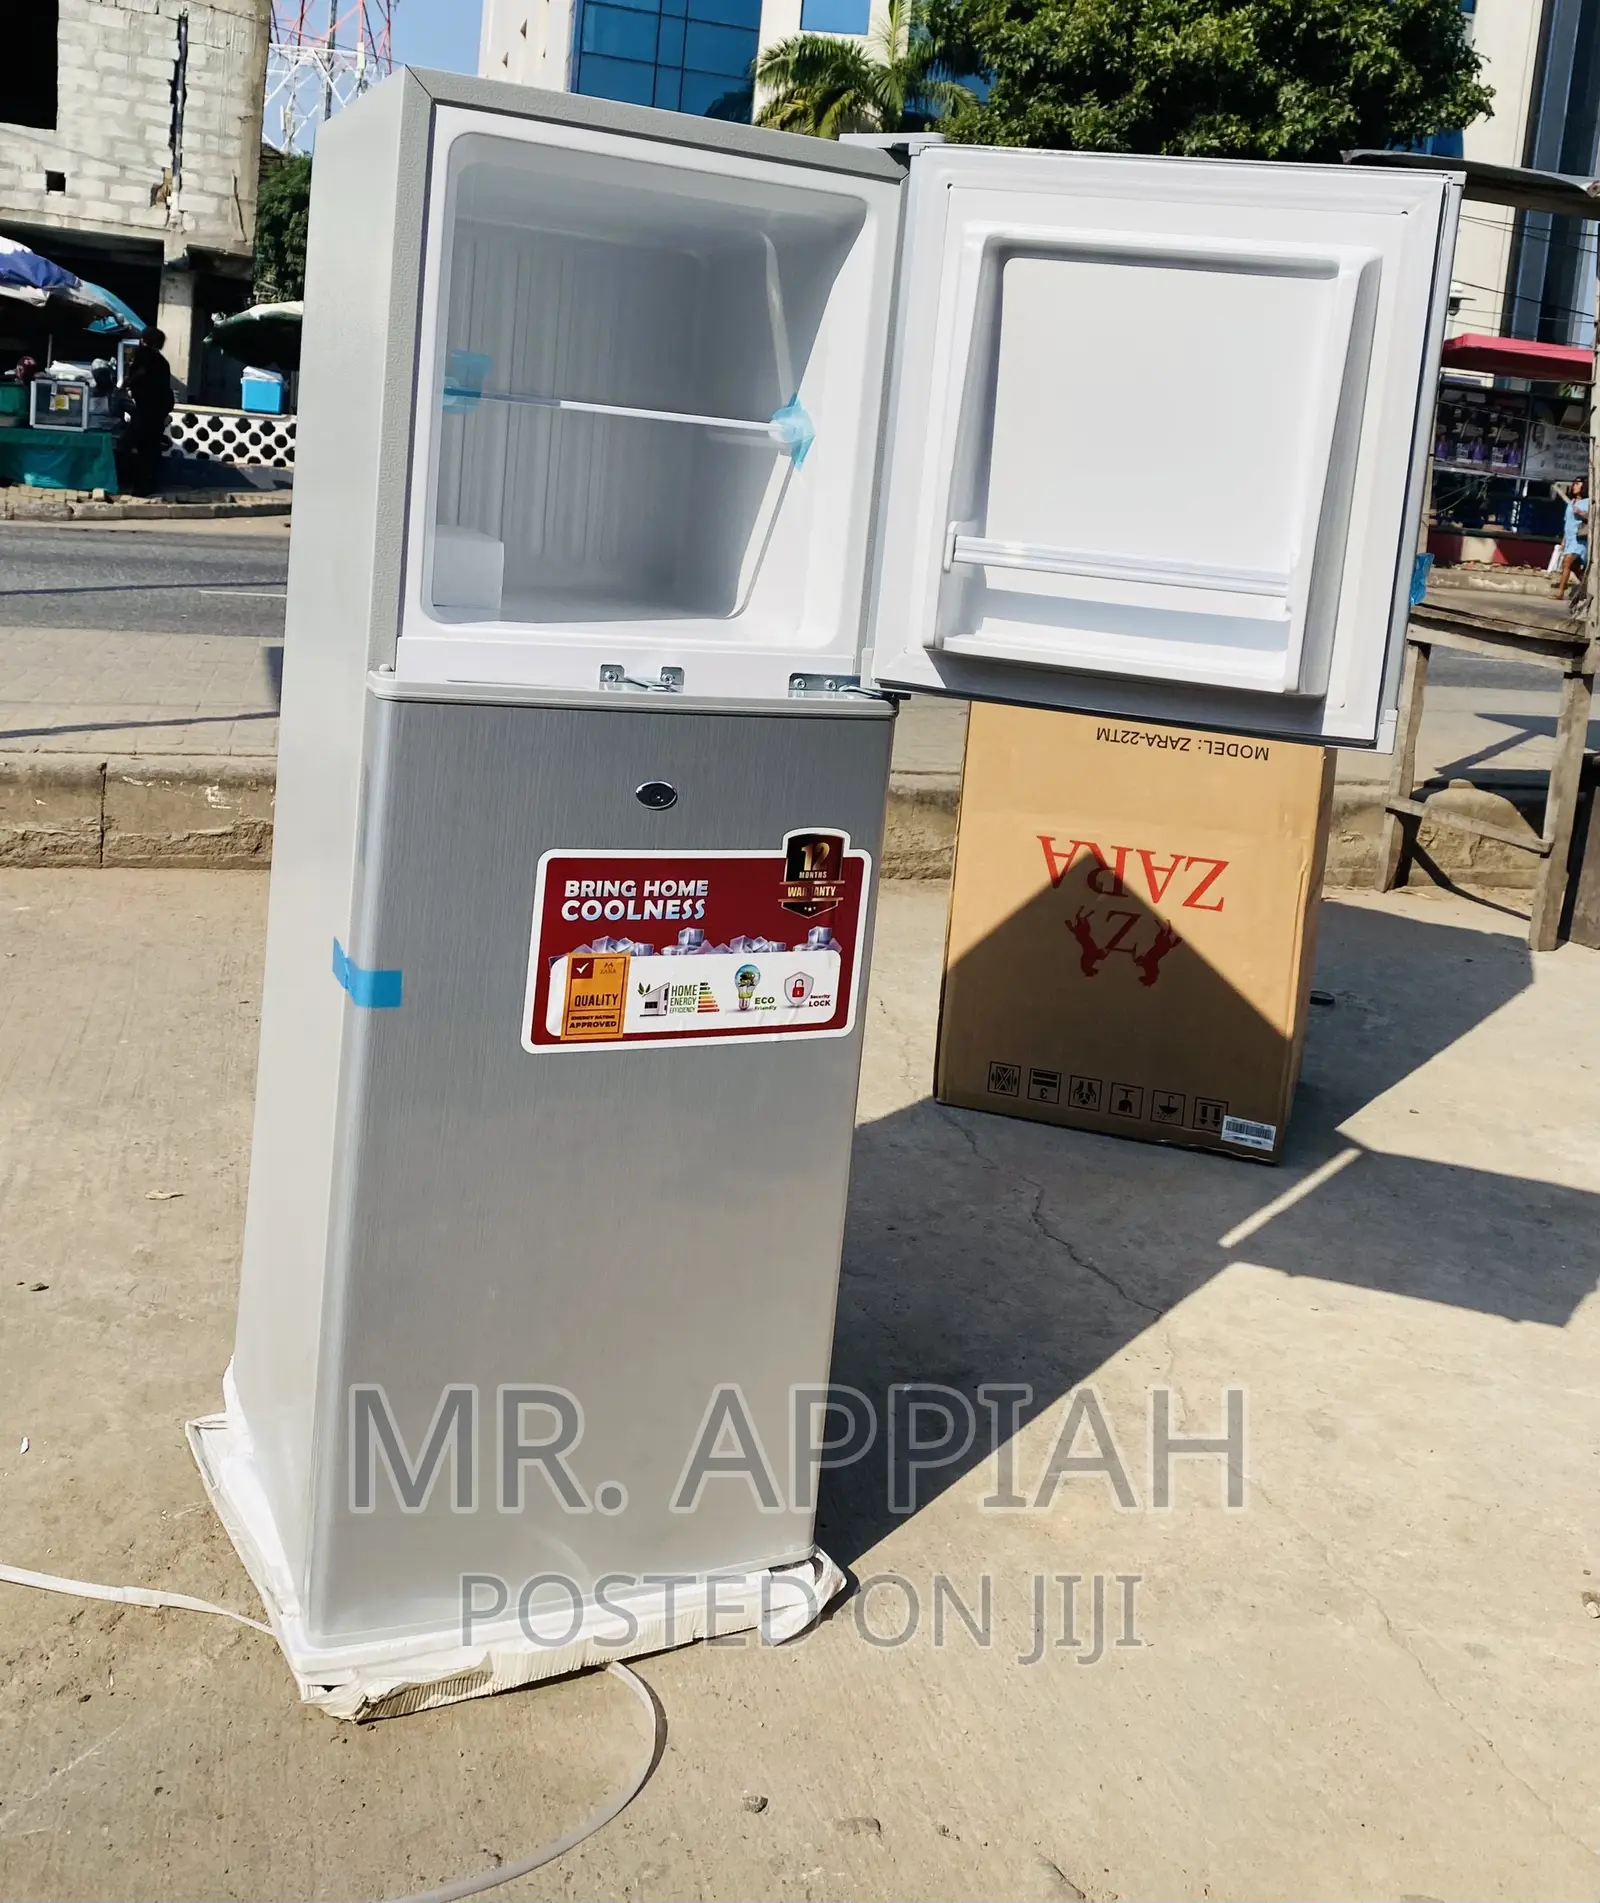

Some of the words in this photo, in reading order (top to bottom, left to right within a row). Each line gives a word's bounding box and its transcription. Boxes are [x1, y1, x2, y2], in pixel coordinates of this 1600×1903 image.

[1096, 727, 1192, 752] ZARA-22TM
[1198, 739, 1270, 761] MODEL:
[801, 842, 830, 871] 12
[798, 871, 828, 879] MONTHS
[1036, 835, 1230, 913] ZARA
[564, 880, 637, 897] BRING
[643, 879, 709, 897] HOME
[561, 898, 706, 921] COOLNESS
[670, 984, 699, 997] HOME
[574, 993, 619, 1007] QUALITY
[670, 996, 697, 1007] ENERGY
[754, 997, 775, 1005] ECO
[808, 999, 832, 1008] LOCK
[569, 1020, 617, 1029] APPROVED
